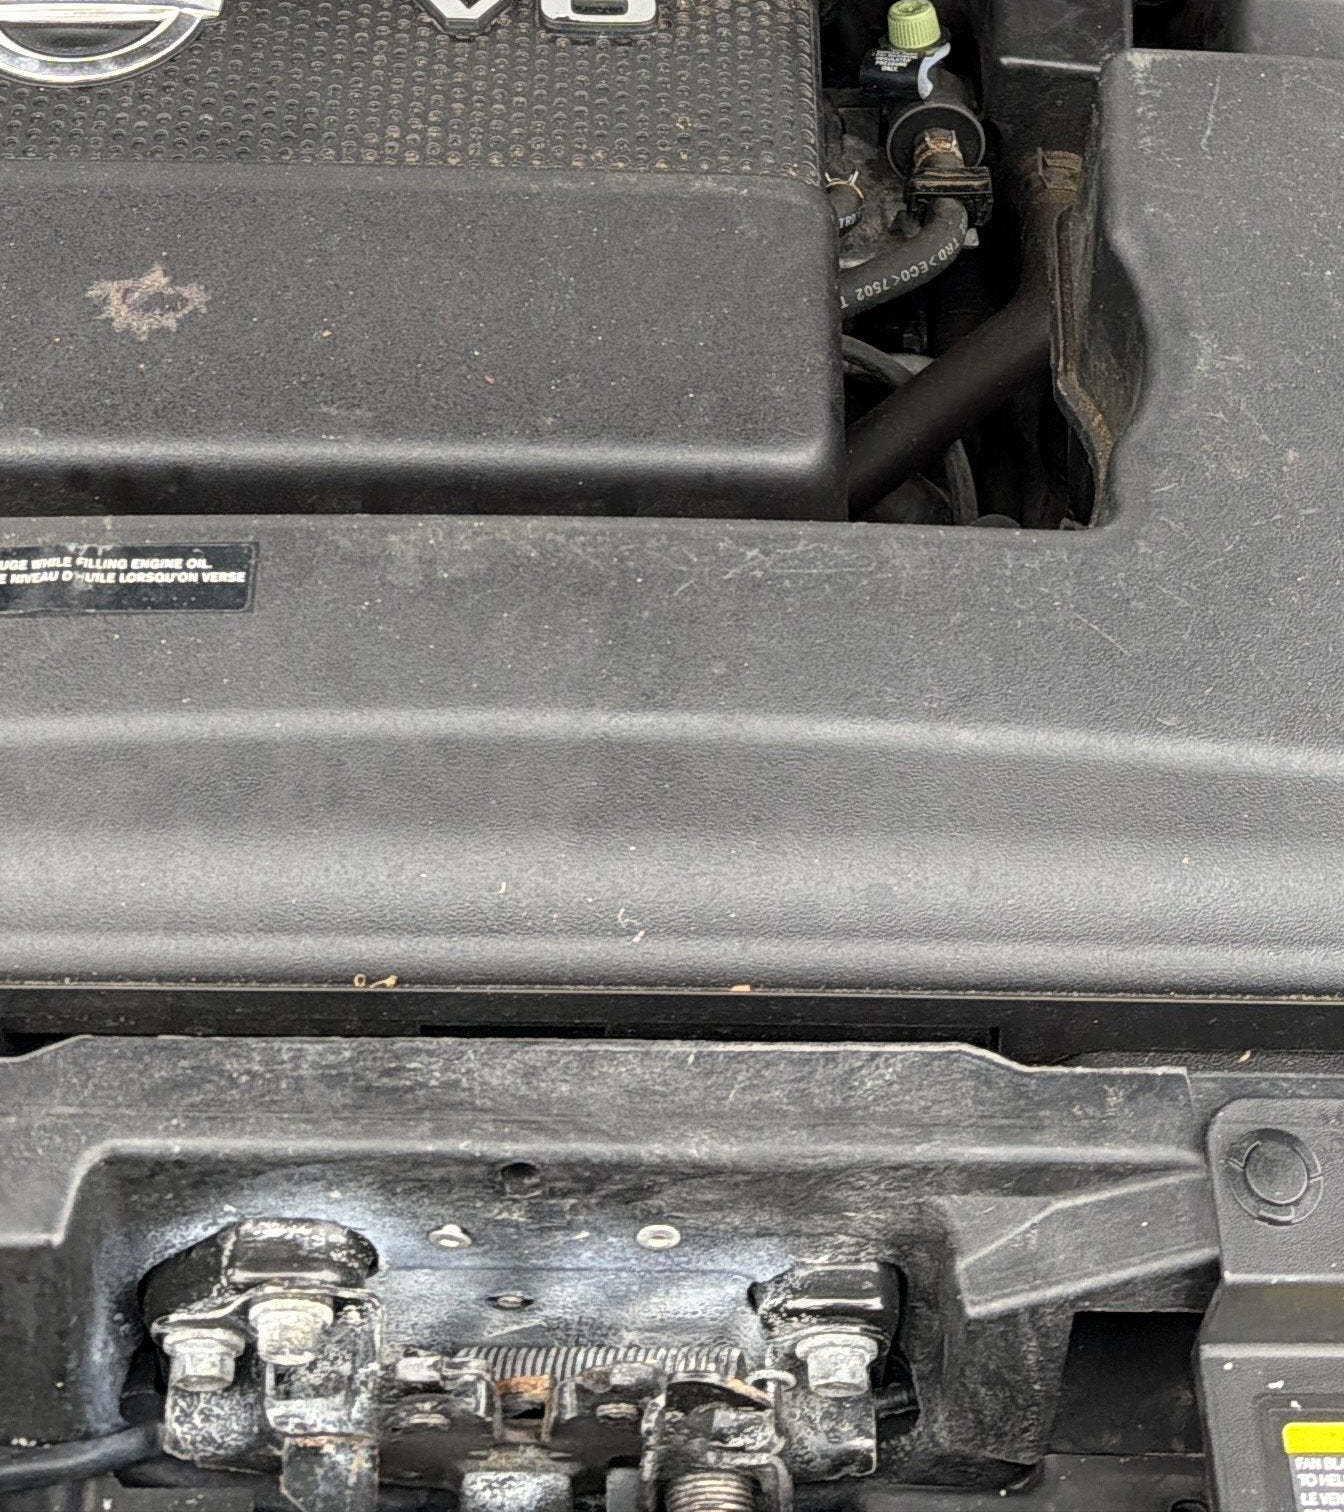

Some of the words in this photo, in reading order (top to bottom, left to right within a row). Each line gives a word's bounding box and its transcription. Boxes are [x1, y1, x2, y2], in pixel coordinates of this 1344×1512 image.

[31, 557, 73, 570] WHILE
[76, 557, 128, 570] FILLING
[131, 558, 184, 570] ENGINE
[186, 558, 213, 570] OIL.
[10, 571, 60, 584] NIVEAU
[119, 571, 199, 584] LORSQU'ON
[201, 571, 246, 583] VERSE
[1294, 1456, 1322, 1471] FAN
[1297, 1473, 1317, 1487] TO
[1301, 1492, 1319, 1506] LE
